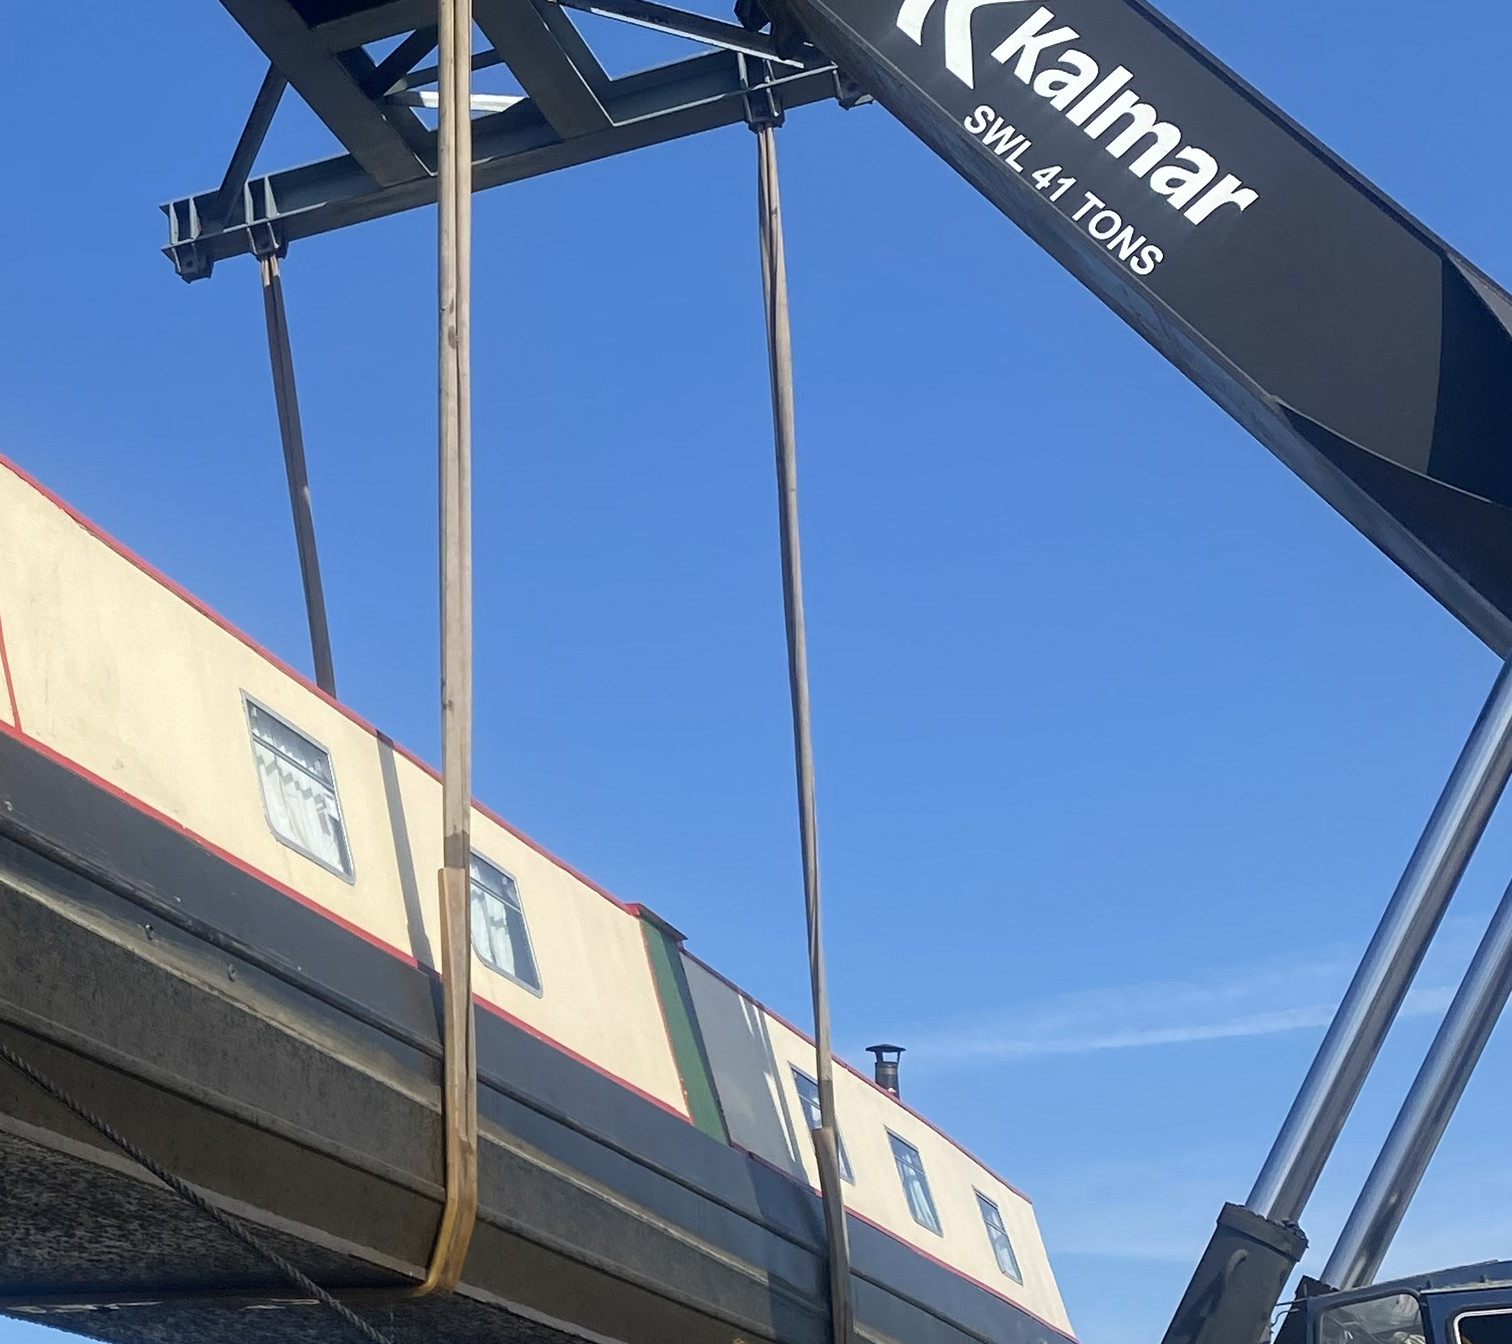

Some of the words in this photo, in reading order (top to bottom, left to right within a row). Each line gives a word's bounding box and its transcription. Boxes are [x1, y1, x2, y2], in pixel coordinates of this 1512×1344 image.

[963, 105, 1032, 173] SWL
[1031, 165, 1077, 202] 41
[1072, 192, 1164, 275] TONS
[991, 6, 1259, 225] Kalmar
